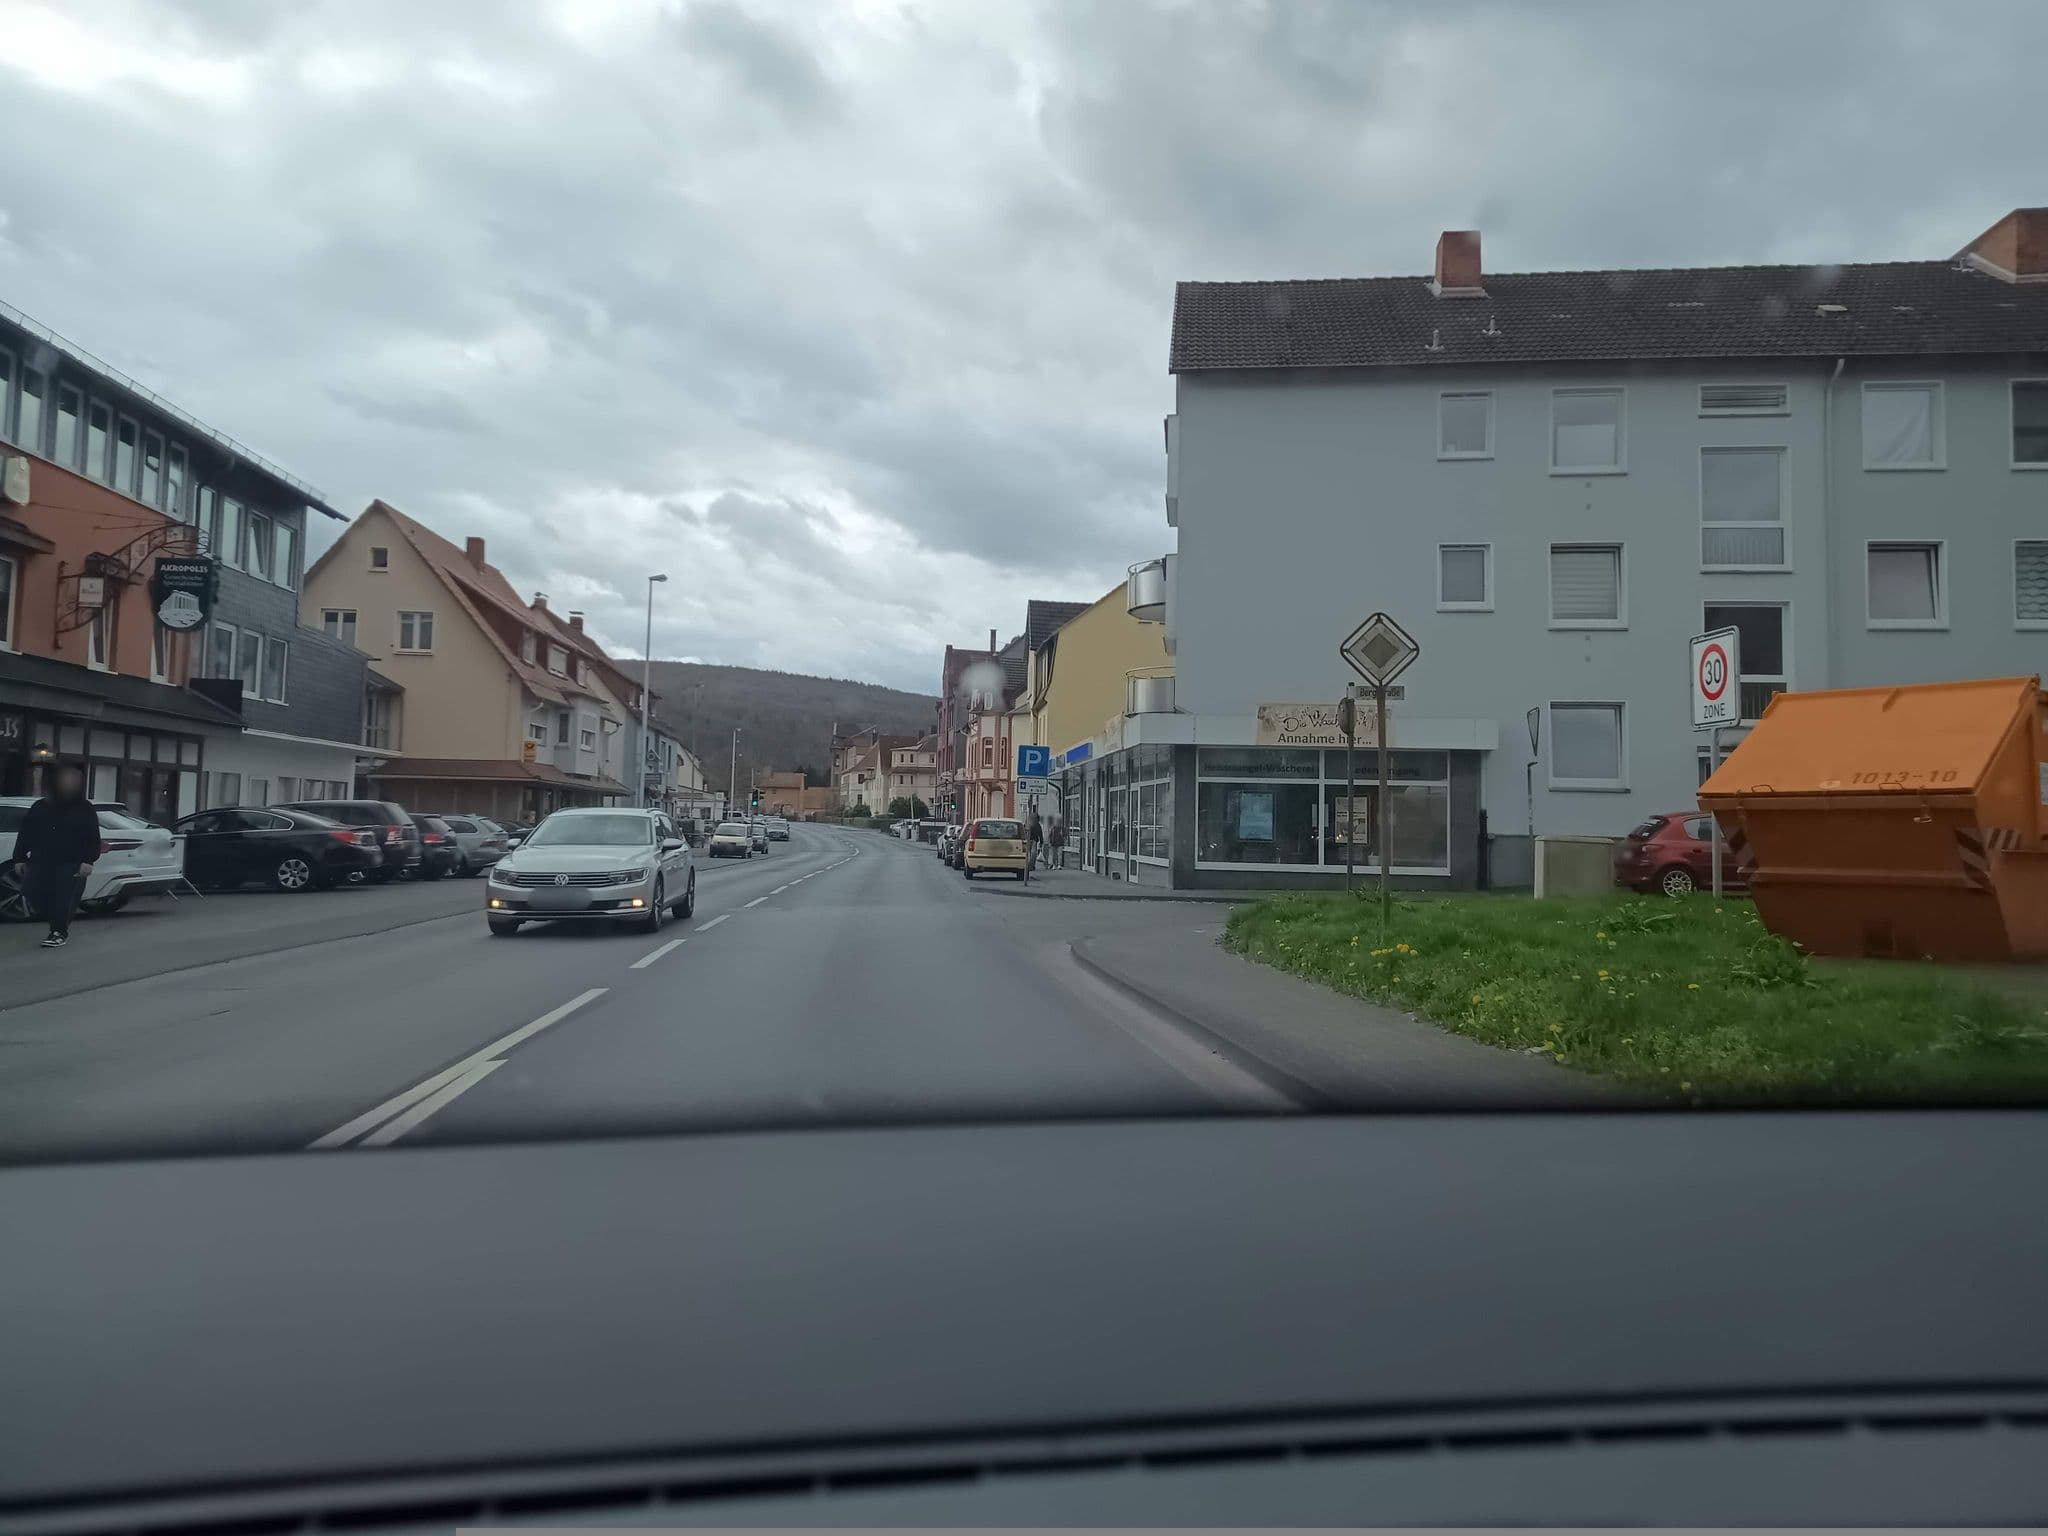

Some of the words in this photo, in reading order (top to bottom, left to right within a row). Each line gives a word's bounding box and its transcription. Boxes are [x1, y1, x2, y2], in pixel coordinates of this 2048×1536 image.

[161, 564, 208, 573] AKROPOLIS
[1705, 659, 1721, 685] 30
[1360, 687, 1401, 699] Bergraße
[1704, 703, 1725, 719] ZONE
[1277, 733, 1335, 745] Annahme
[1024, 750, 1042, 773] P
